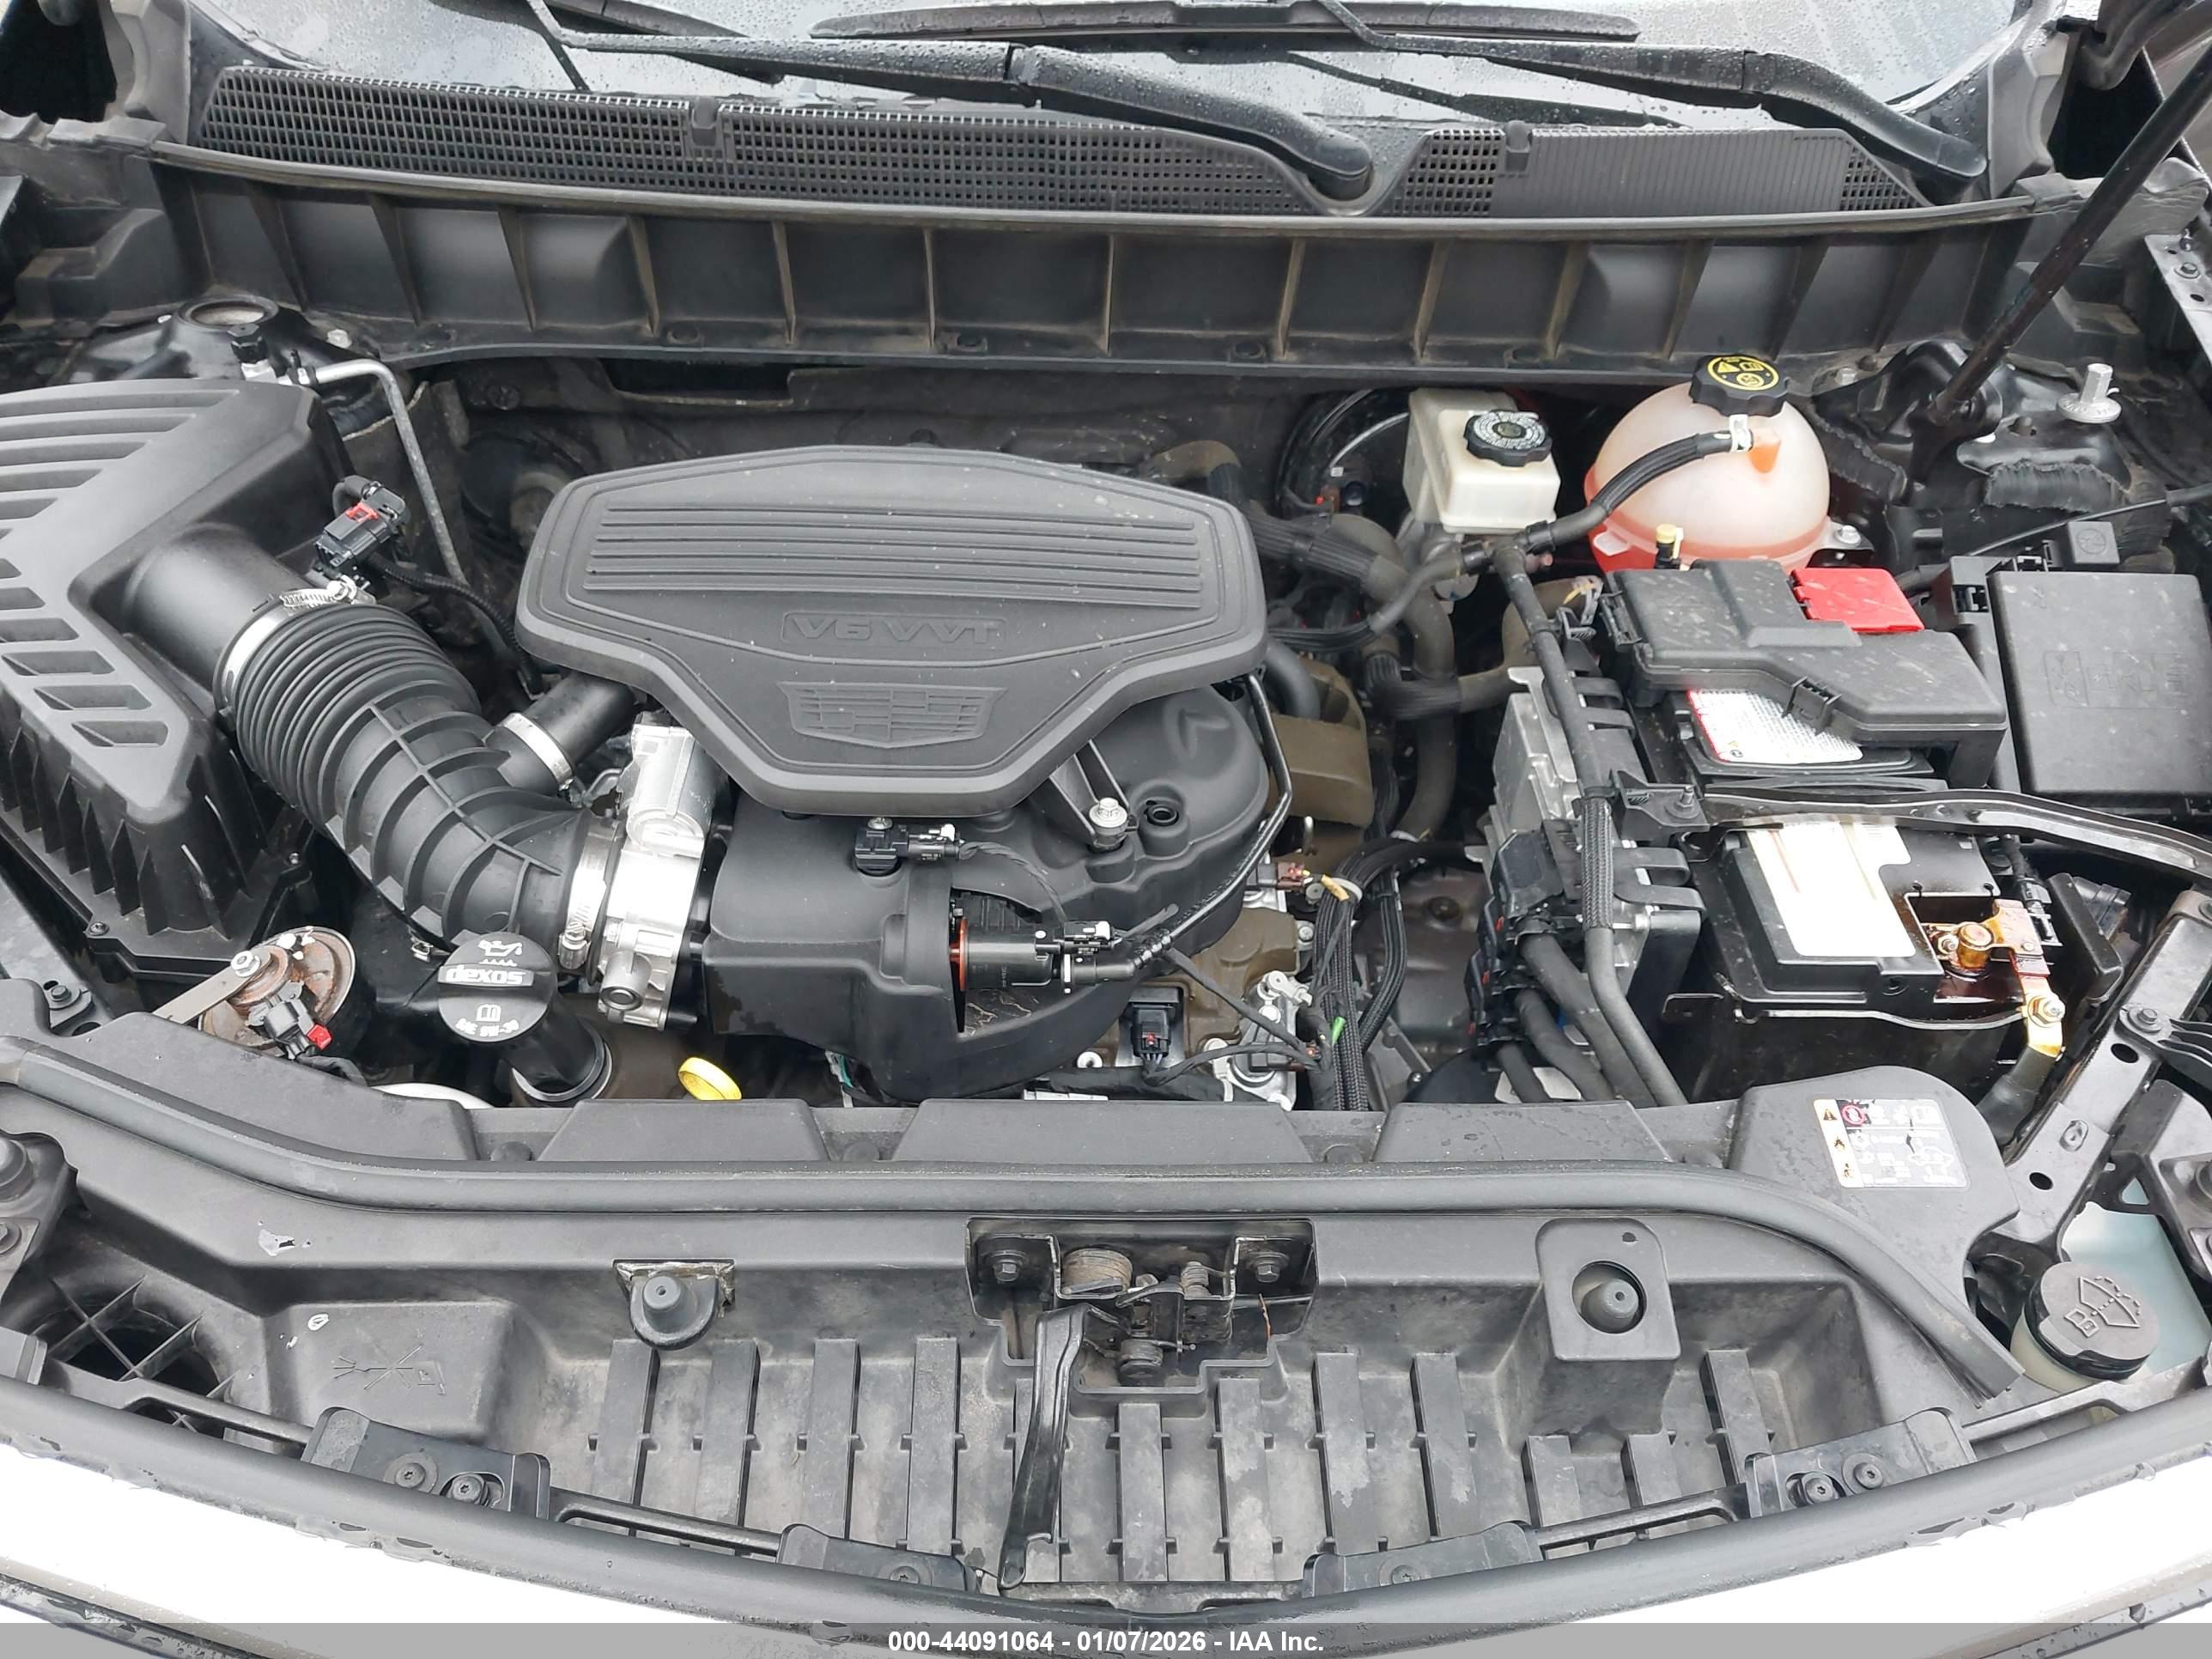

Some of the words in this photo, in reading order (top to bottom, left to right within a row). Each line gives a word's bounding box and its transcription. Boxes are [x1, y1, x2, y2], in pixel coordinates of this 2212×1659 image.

[793, 617, 872, 641] V6
[884, 618, 1003, 645] VVT
[446, 964, 526, 985] dexos
